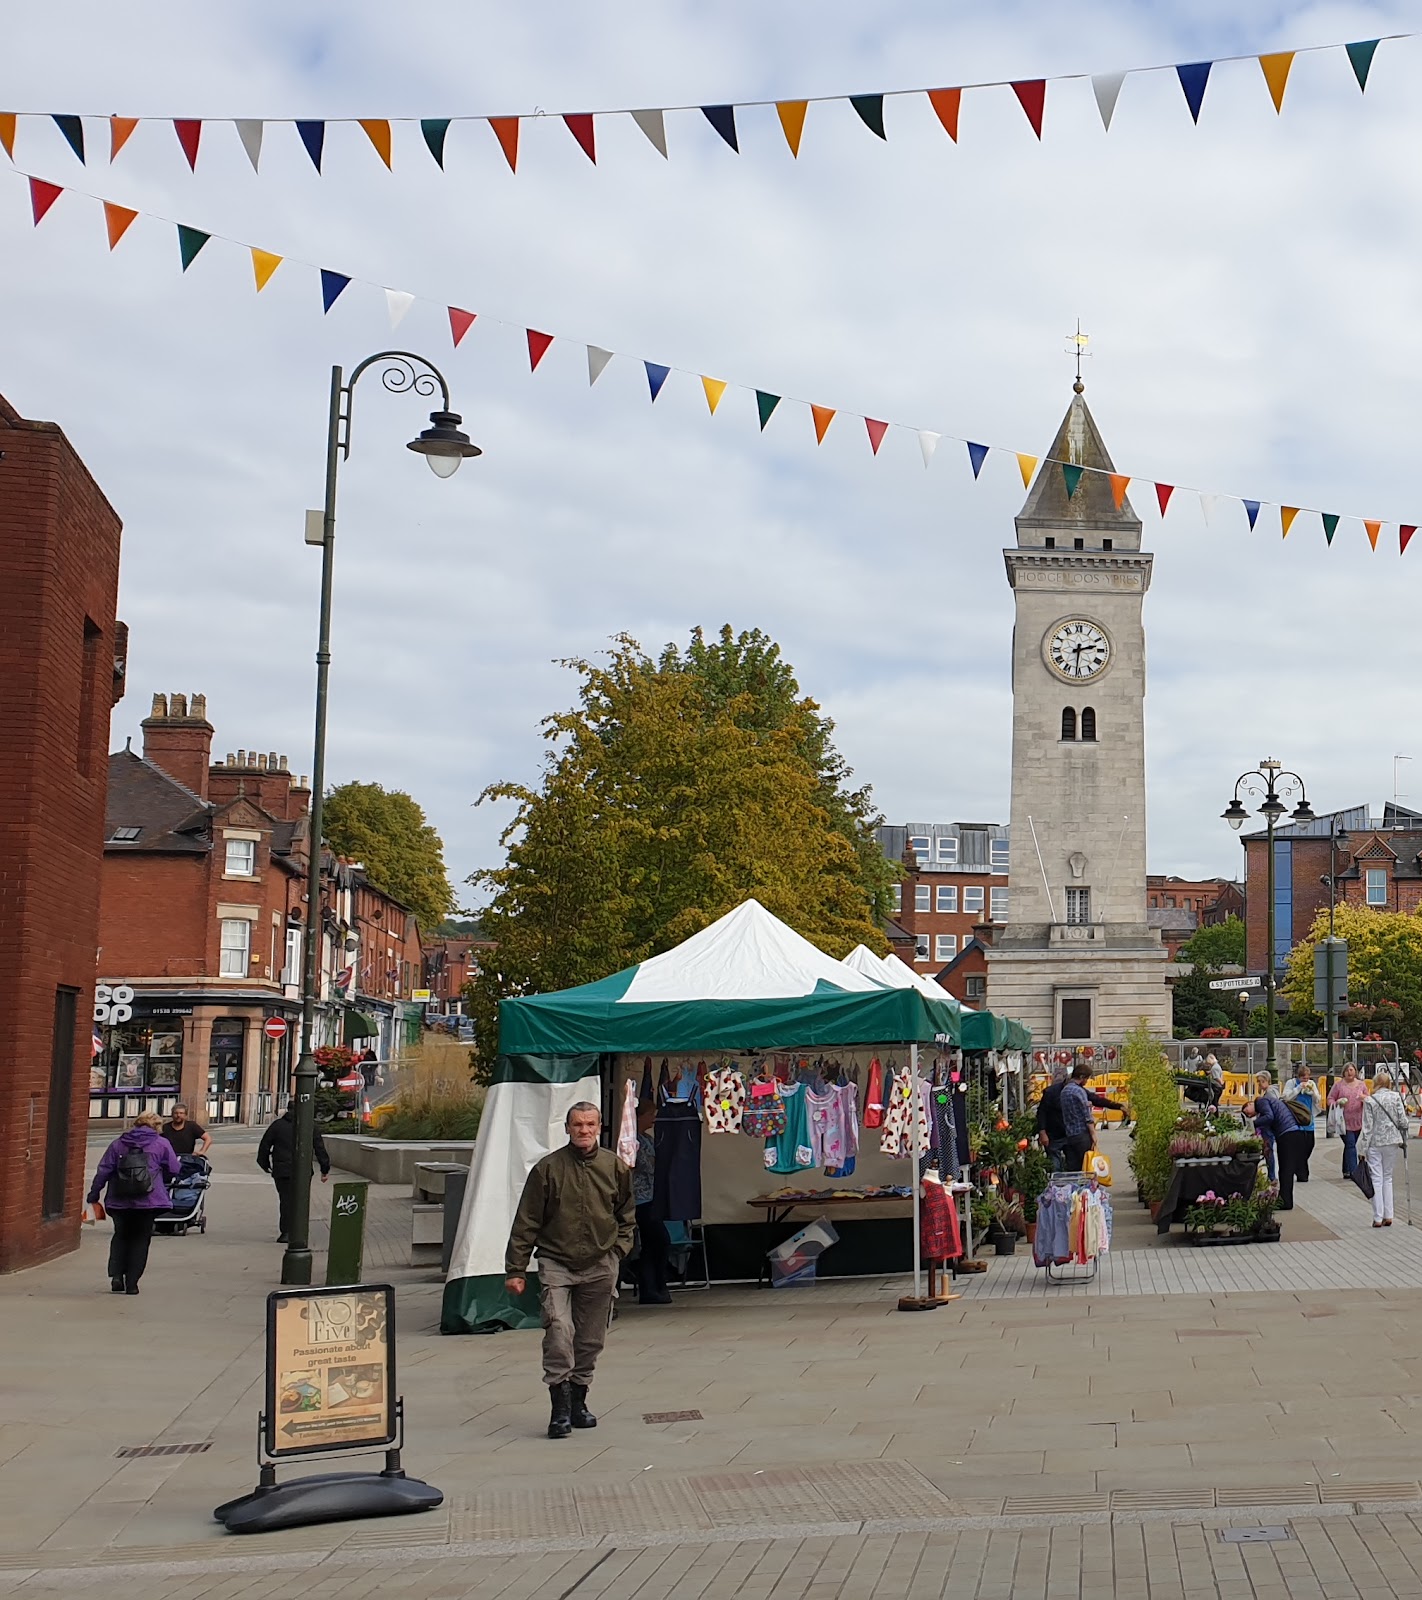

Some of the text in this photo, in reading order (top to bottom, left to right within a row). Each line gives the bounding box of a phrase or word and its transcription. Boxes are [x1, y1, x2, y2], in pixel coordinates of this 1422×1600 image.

[314, 1322, 350, 1341] Five
[292, 1342, 371, 1357] Passionate about
[307, 1354, 357, 1368] great taste
